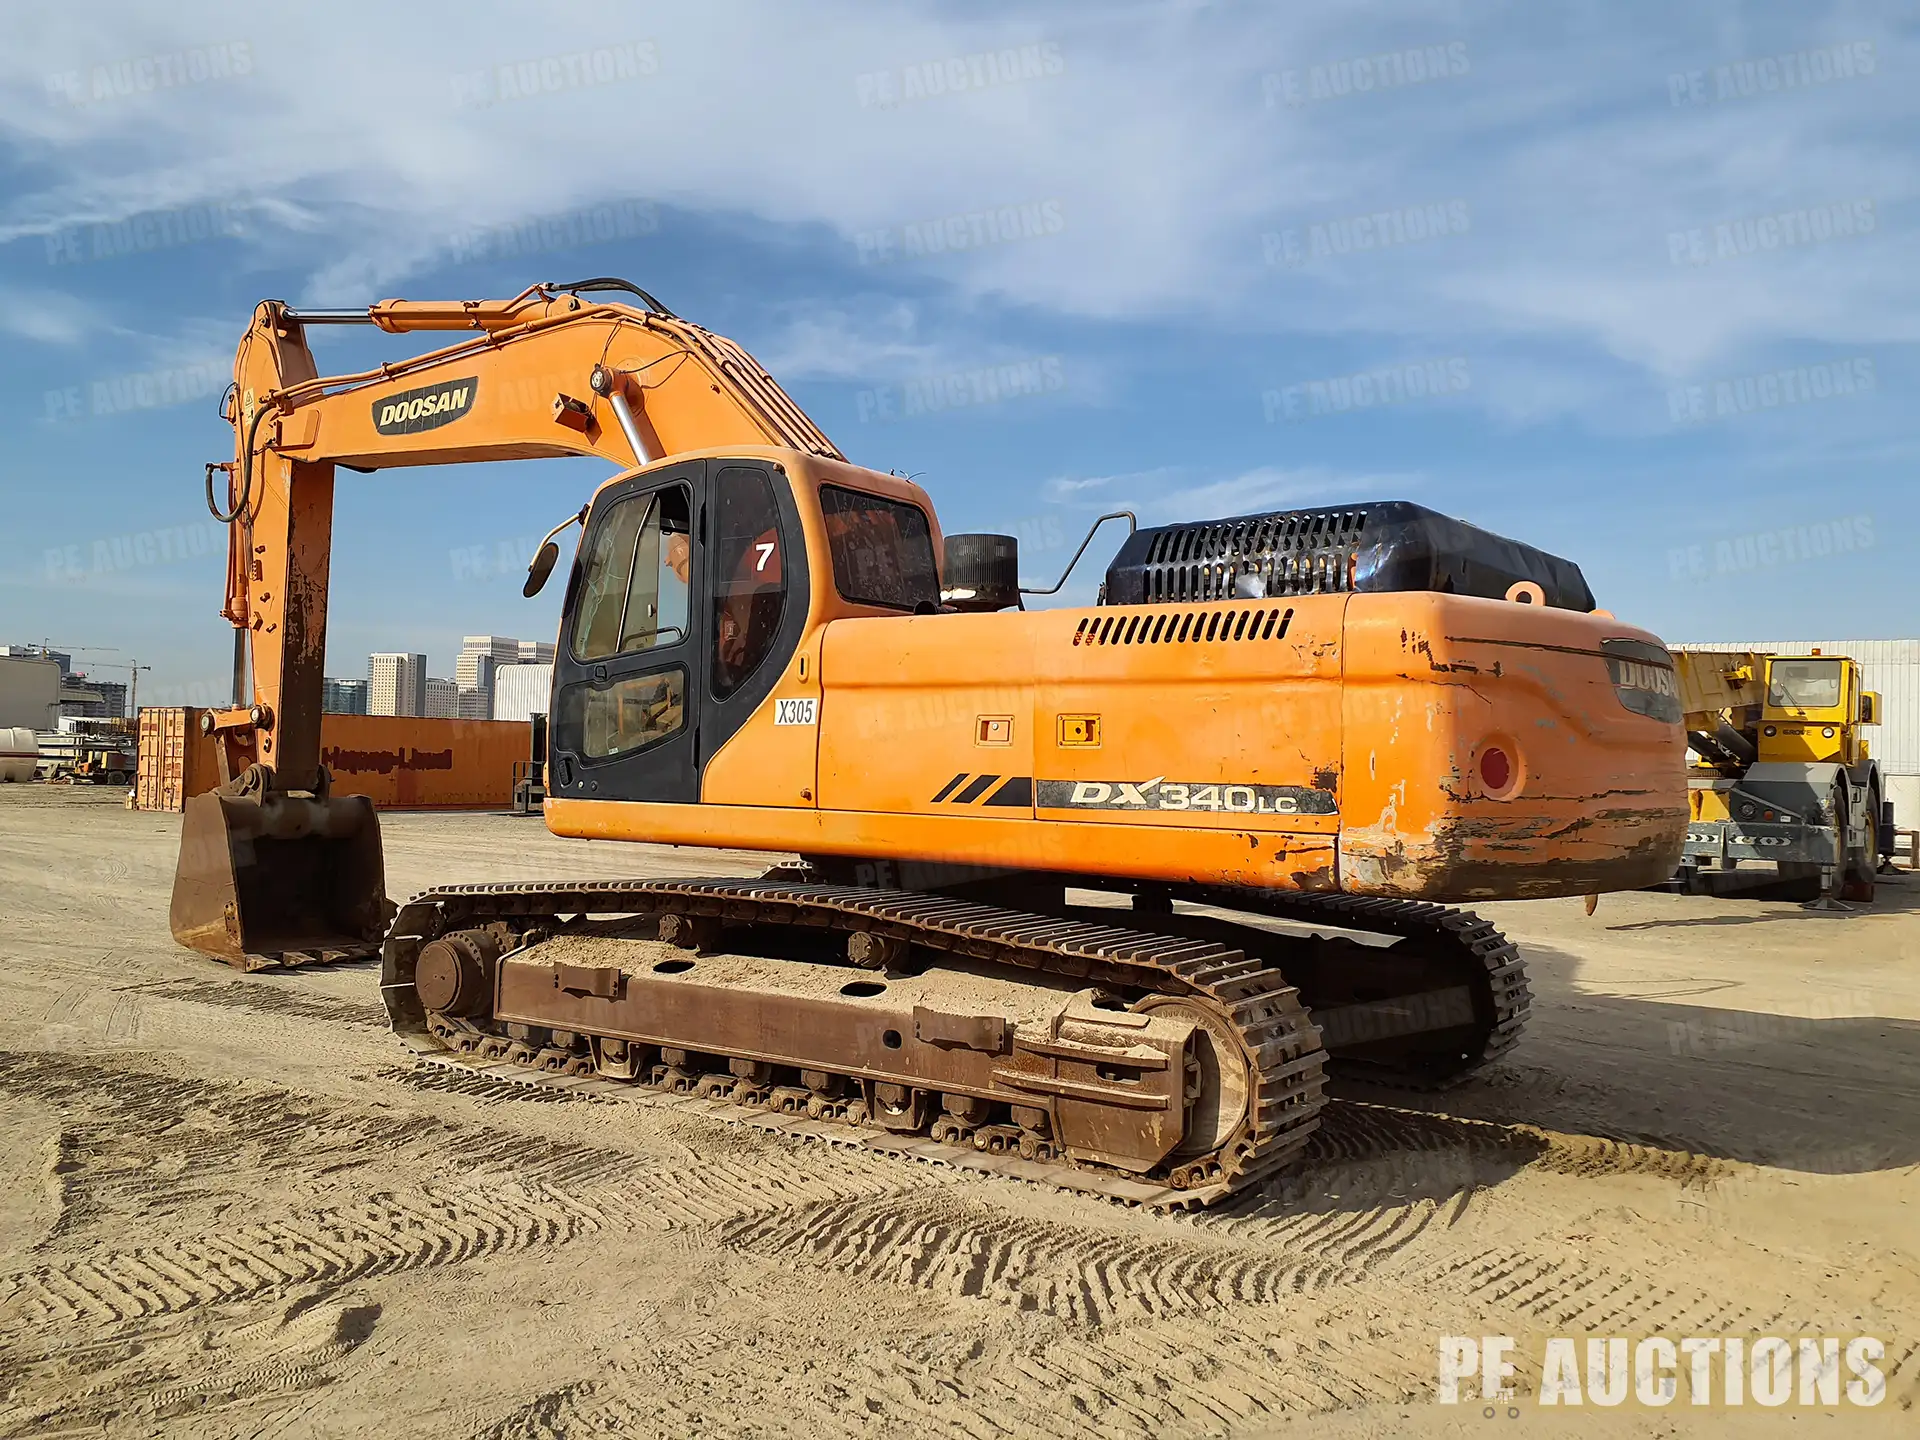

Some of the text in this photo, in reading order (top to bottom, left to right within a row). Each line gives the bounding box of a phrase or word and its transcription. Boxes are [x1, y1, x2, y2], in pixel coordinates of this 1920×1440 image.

[380, 387, 469, 427] DOOSAN
[755, 543, 775, 571] 7
[1619, 661, 1678, 699] DOOSA
[778, 700, 813, 724] X305
